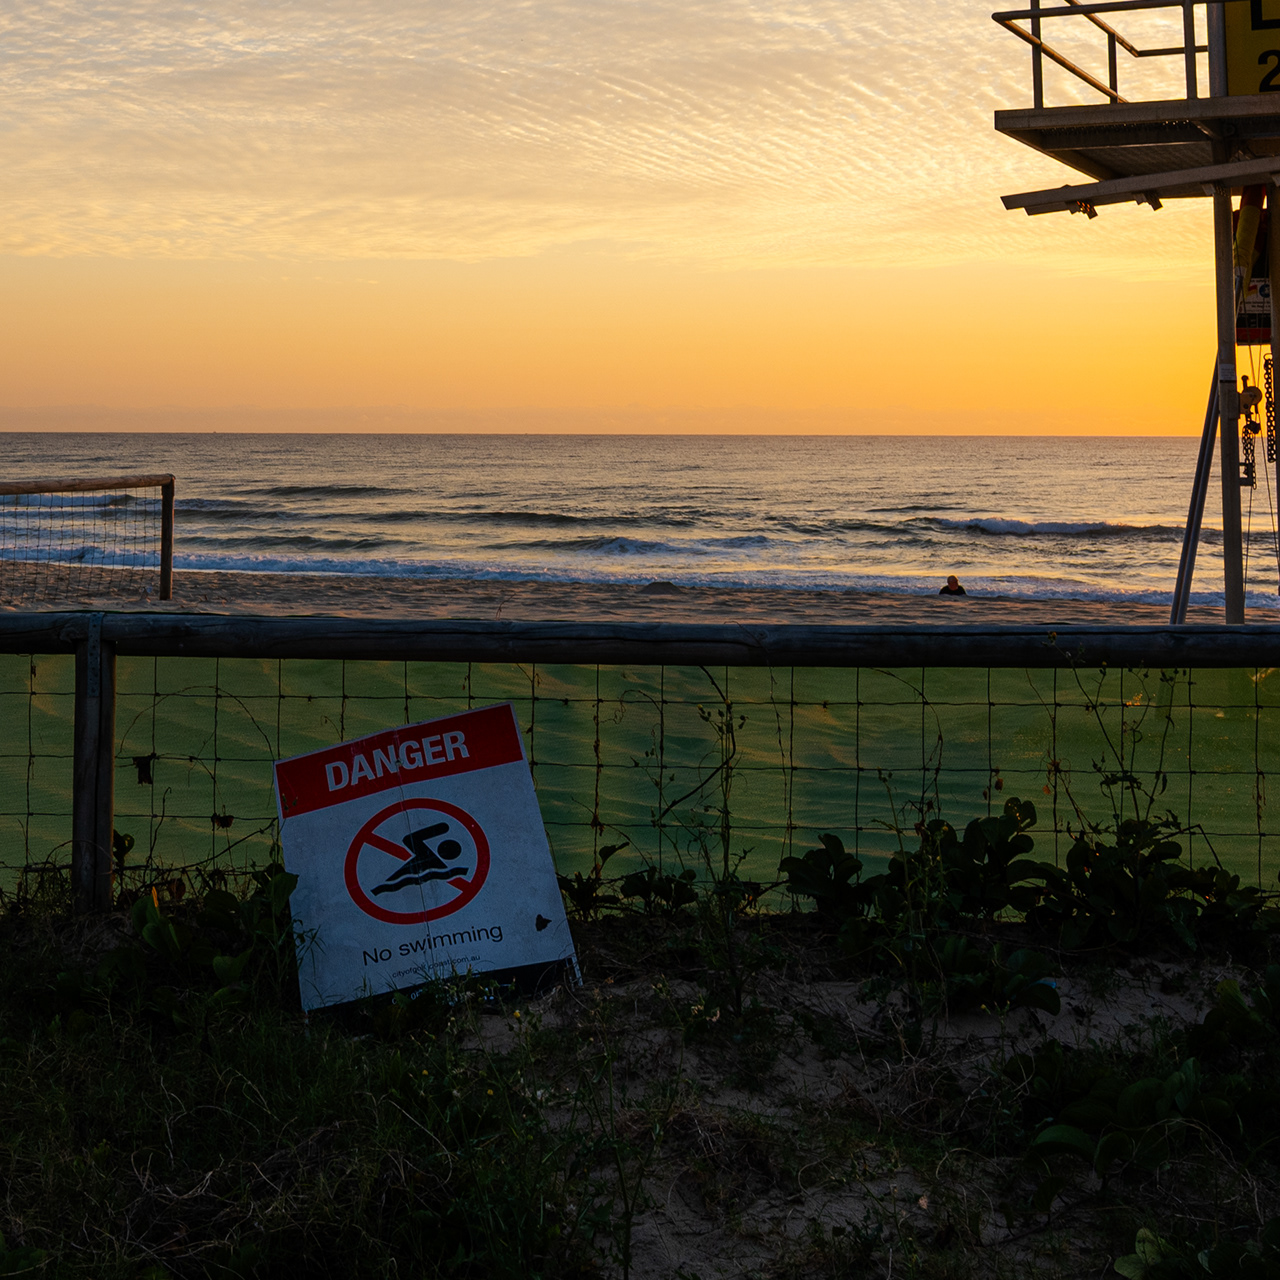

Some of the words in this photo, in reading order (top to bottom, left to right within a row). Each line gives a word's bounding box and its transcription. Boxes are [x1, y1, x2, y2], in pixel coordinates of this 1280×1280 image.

[324, 730, 470, 792] DANGER
[362, 947, 393, 966] No
[399, 923, 503, 956] swimming
